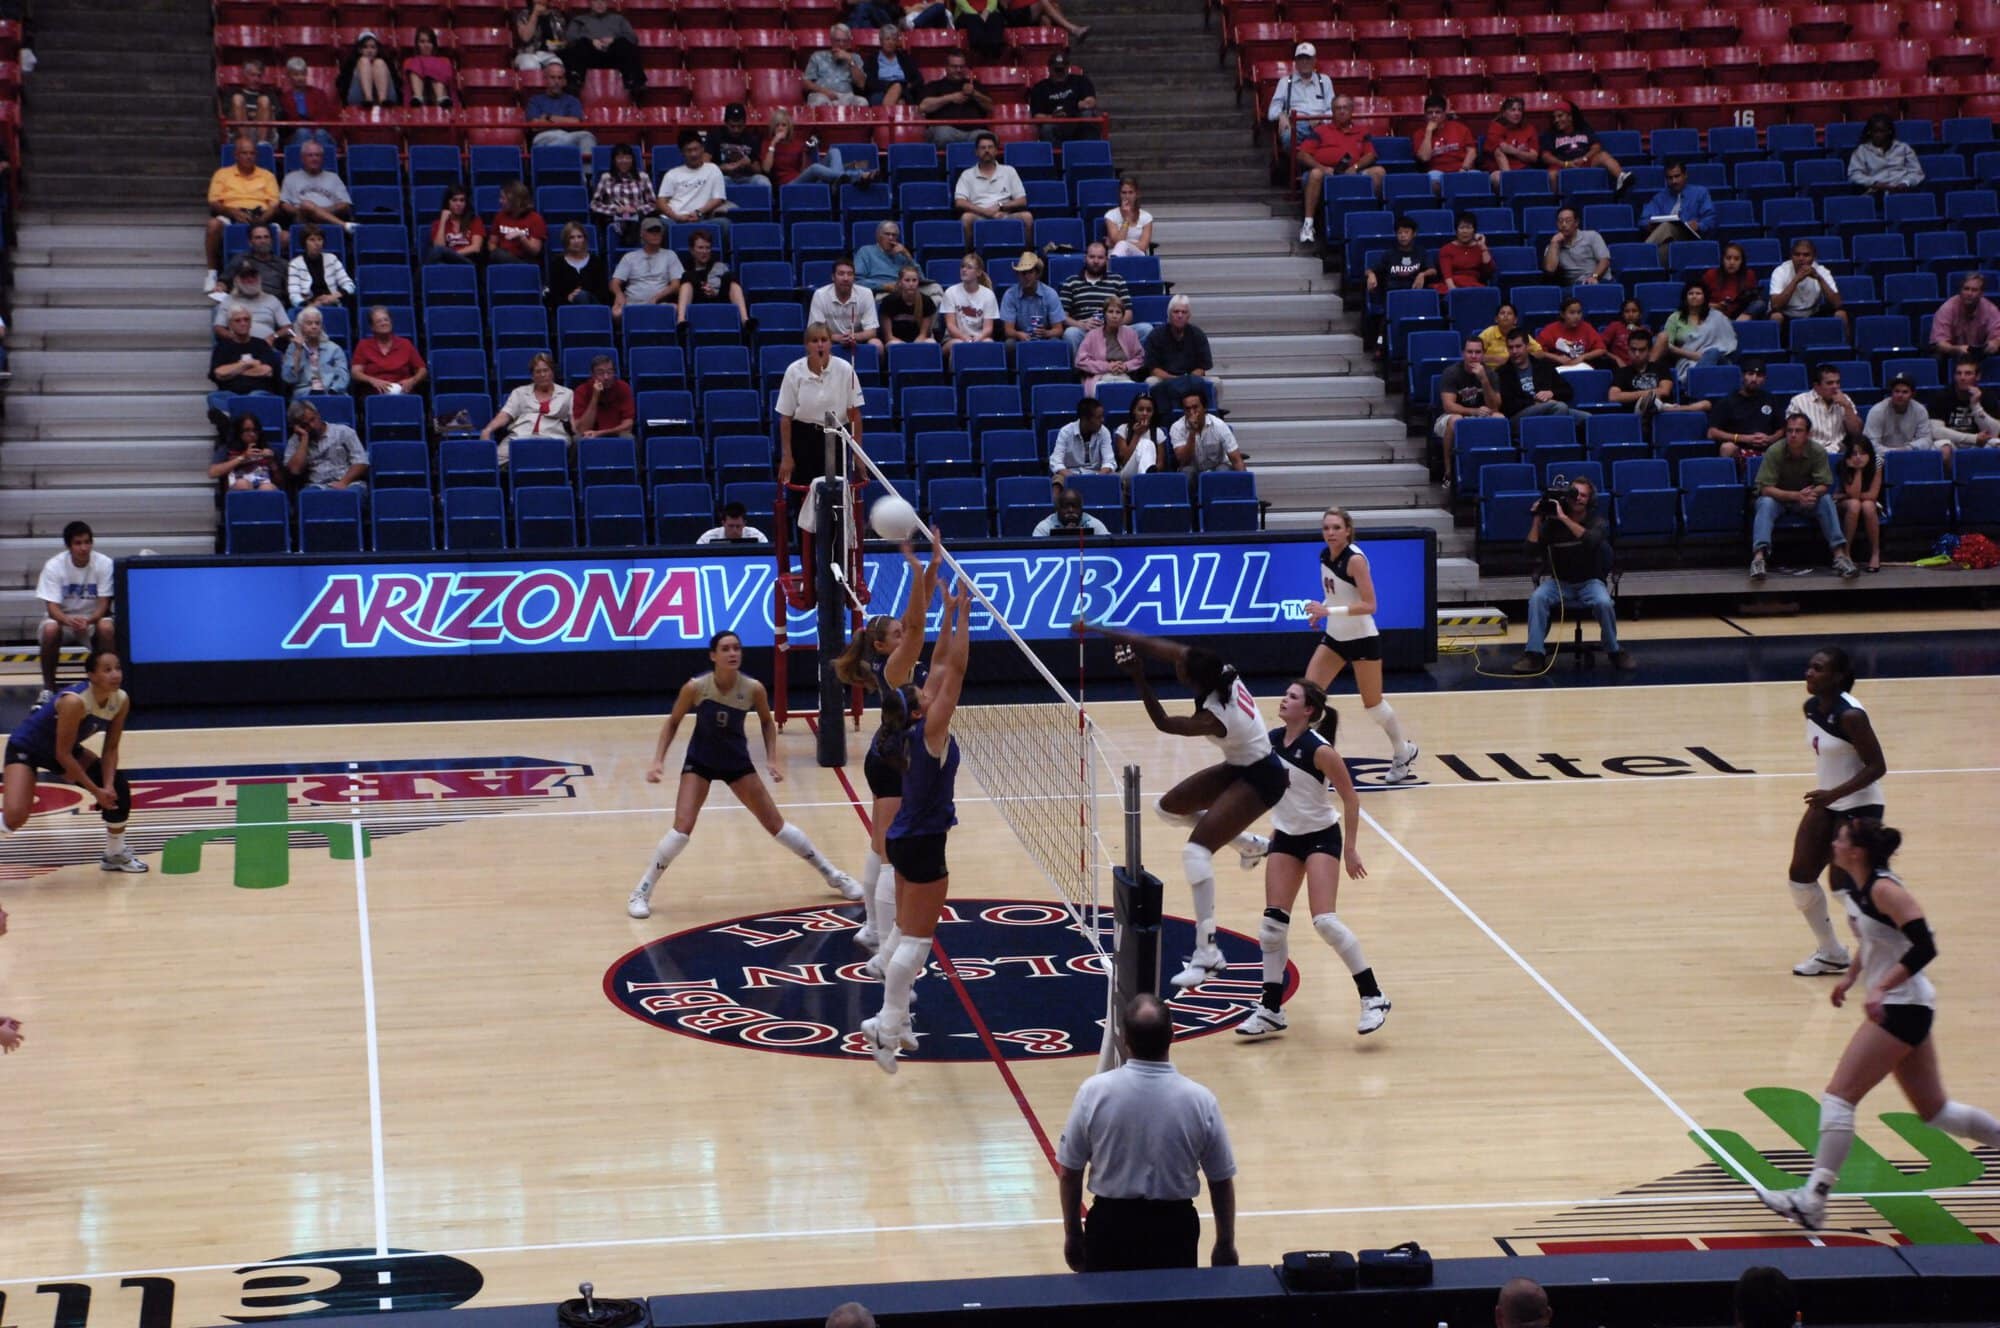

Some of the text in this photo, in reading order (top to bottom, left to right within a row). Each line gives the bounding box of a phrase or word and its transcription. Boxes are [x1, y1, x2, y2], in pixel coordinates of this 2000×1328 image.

[1734, 109, 1755, 128] 16
[1391, 263, 1420, 274] ARIZON
[280, 567, 709, 650] ARIZONA
[717, 711, 729, 728] 9
